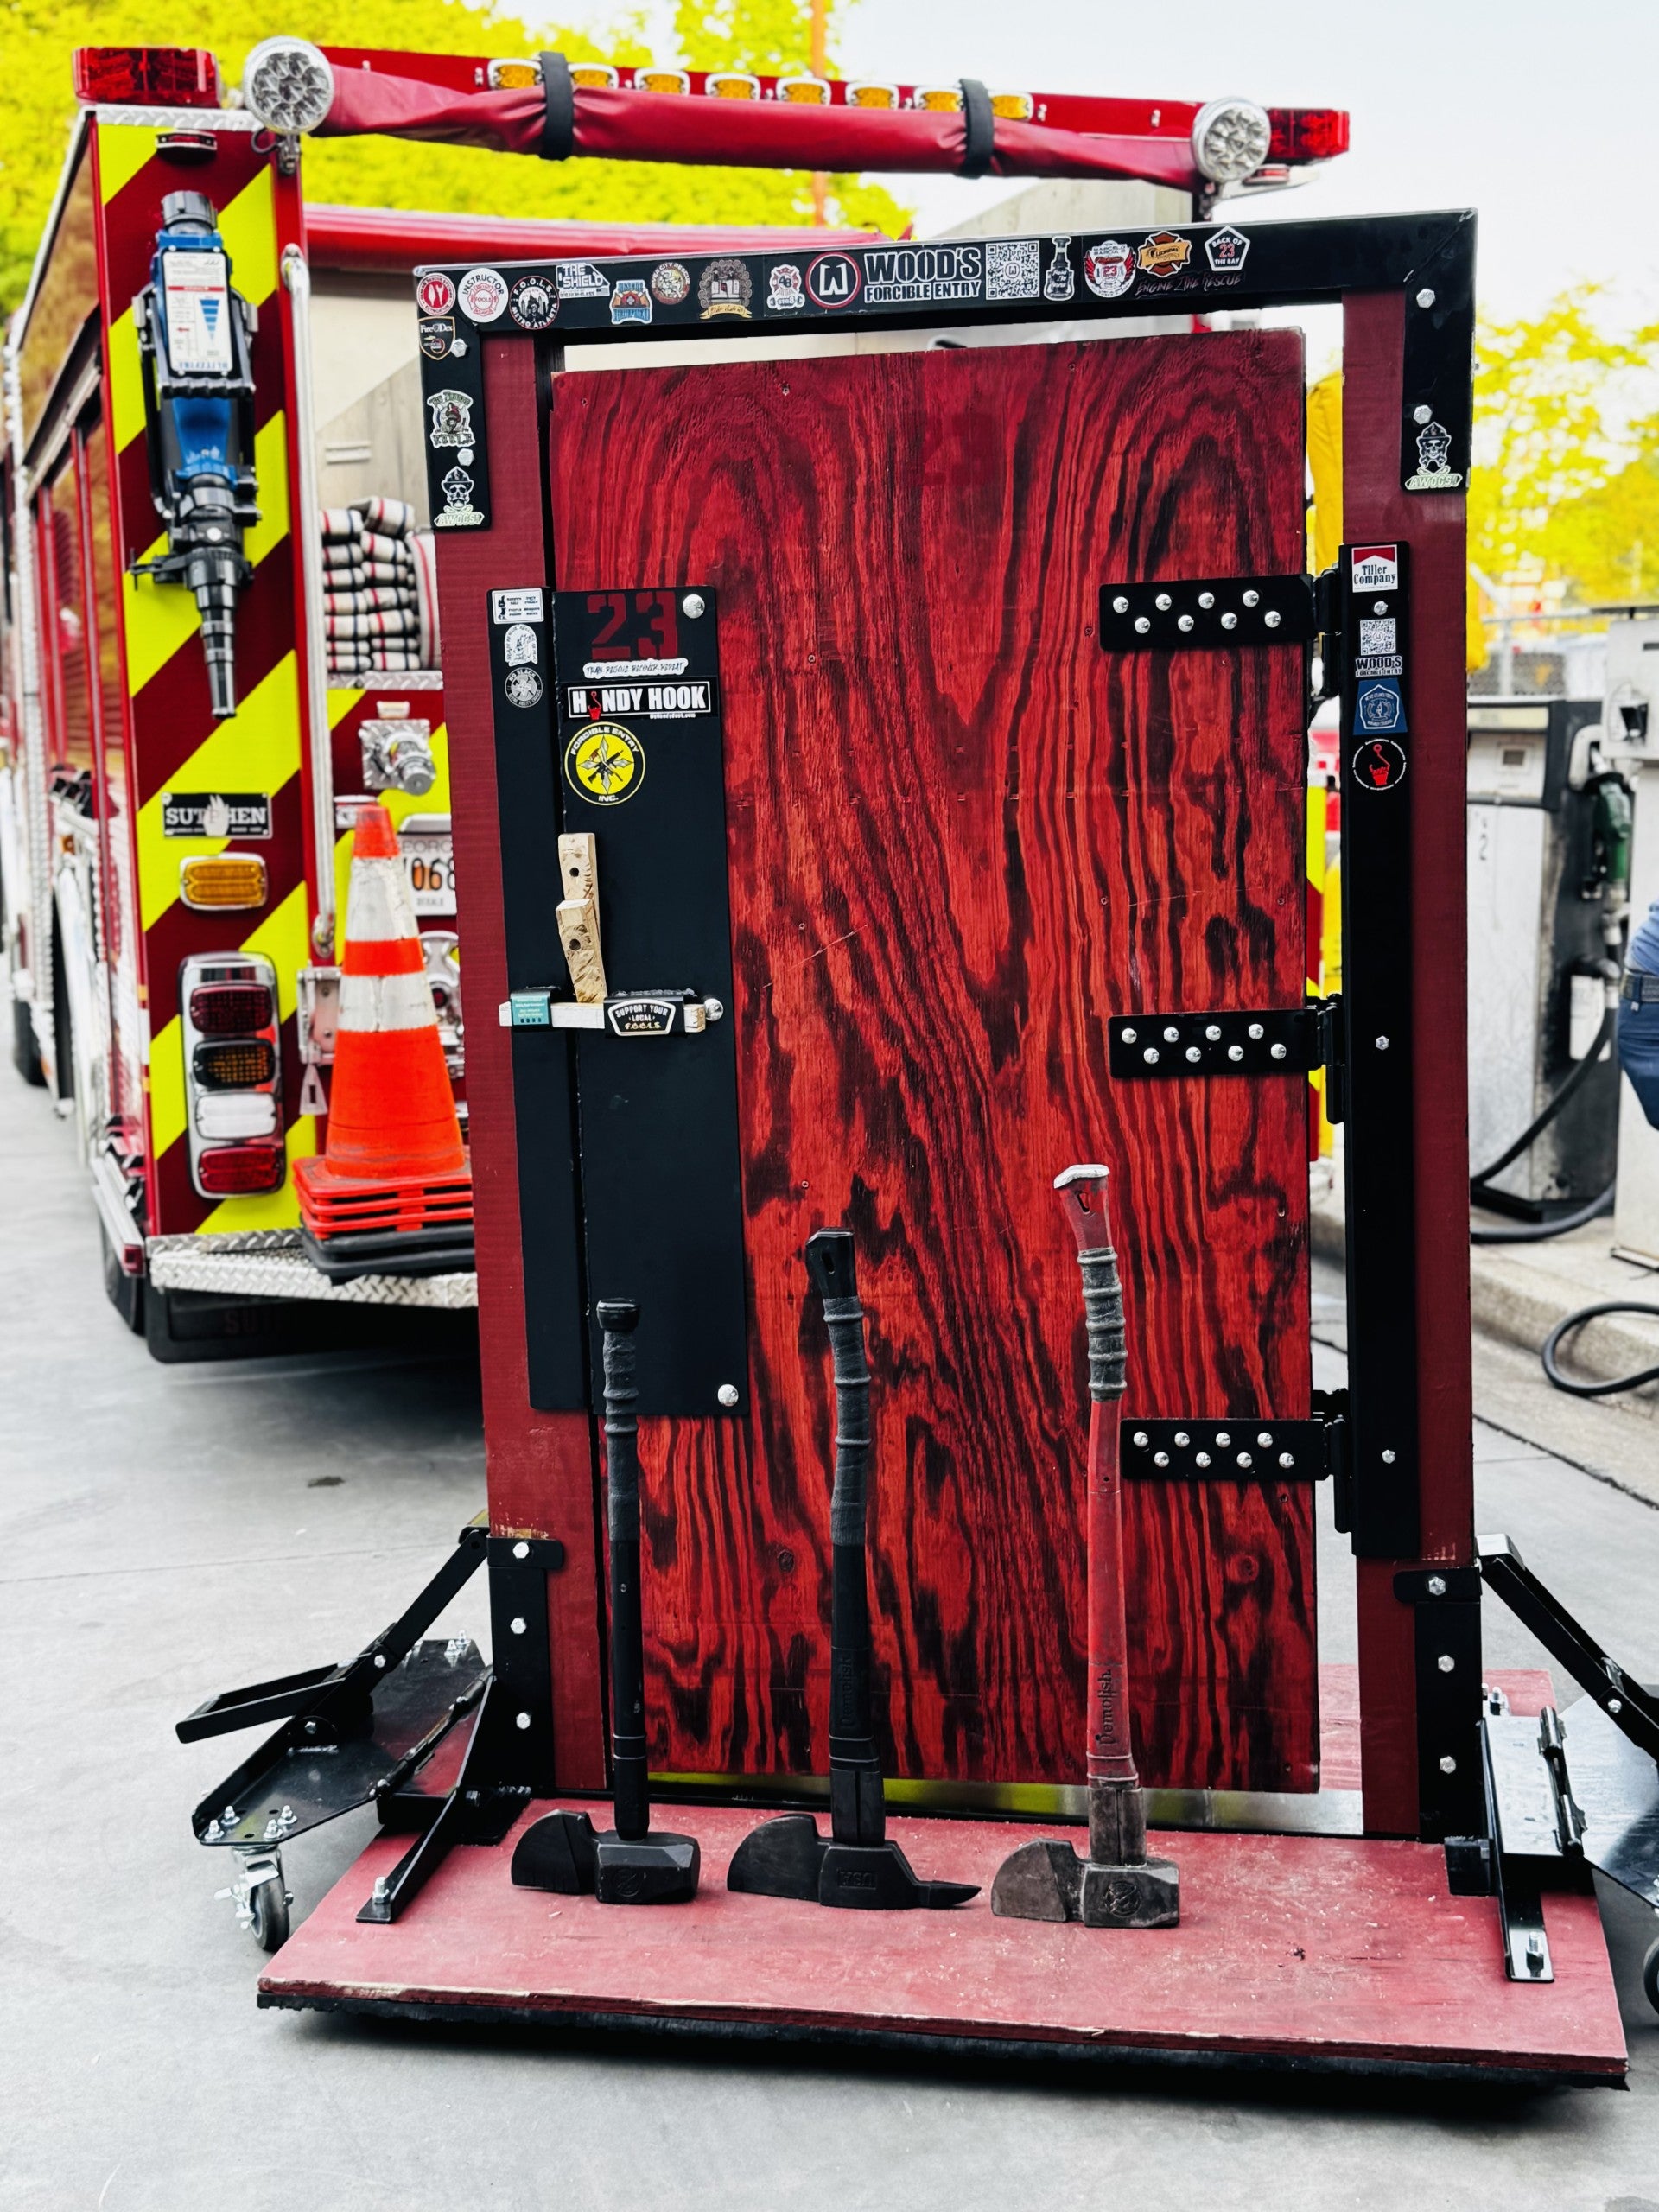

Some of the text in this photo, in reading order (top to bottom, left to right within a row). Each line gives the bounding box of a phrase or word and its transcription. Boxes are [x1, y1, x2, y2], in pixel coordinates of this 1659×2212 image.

[1211, 237, 1230, 248] BACK
[1219, 243, 1236, 258] 23
[563, 264, 586, 276] THE
[659, 262, 673, 270] CITY
[864, 247, 982, 284] WOOD'S
[1103, 265, 1117, 276] 23
[462, 274, 505, 295] INSTRUCTOR
[563, 276, 603, 289] SHIELD
[779, 275, 792, 288] 48
[864, 280, 982, 303] FORCIBLE ENTRY
[512, 302, 558, 328] METRO ATLANTA
[1362, 564, 1387, 575] Tiller
[1354, 574, 1396, 585] Company
[587, 591, 678, 659] 23
[1355, 656, 1402, 671] WOOD'S
[648, 685, 707, 710] HOOK
[570, 726, 639, 755] FORCIBLE ENTRY
[598, 794, 620, 803] INC.
[165, 806, 267, 825] SUTPHEN
[614, 1004, 669, 1018] SUPPORT YOUR
[1096, 1669, 1118, 1745] Demolish
